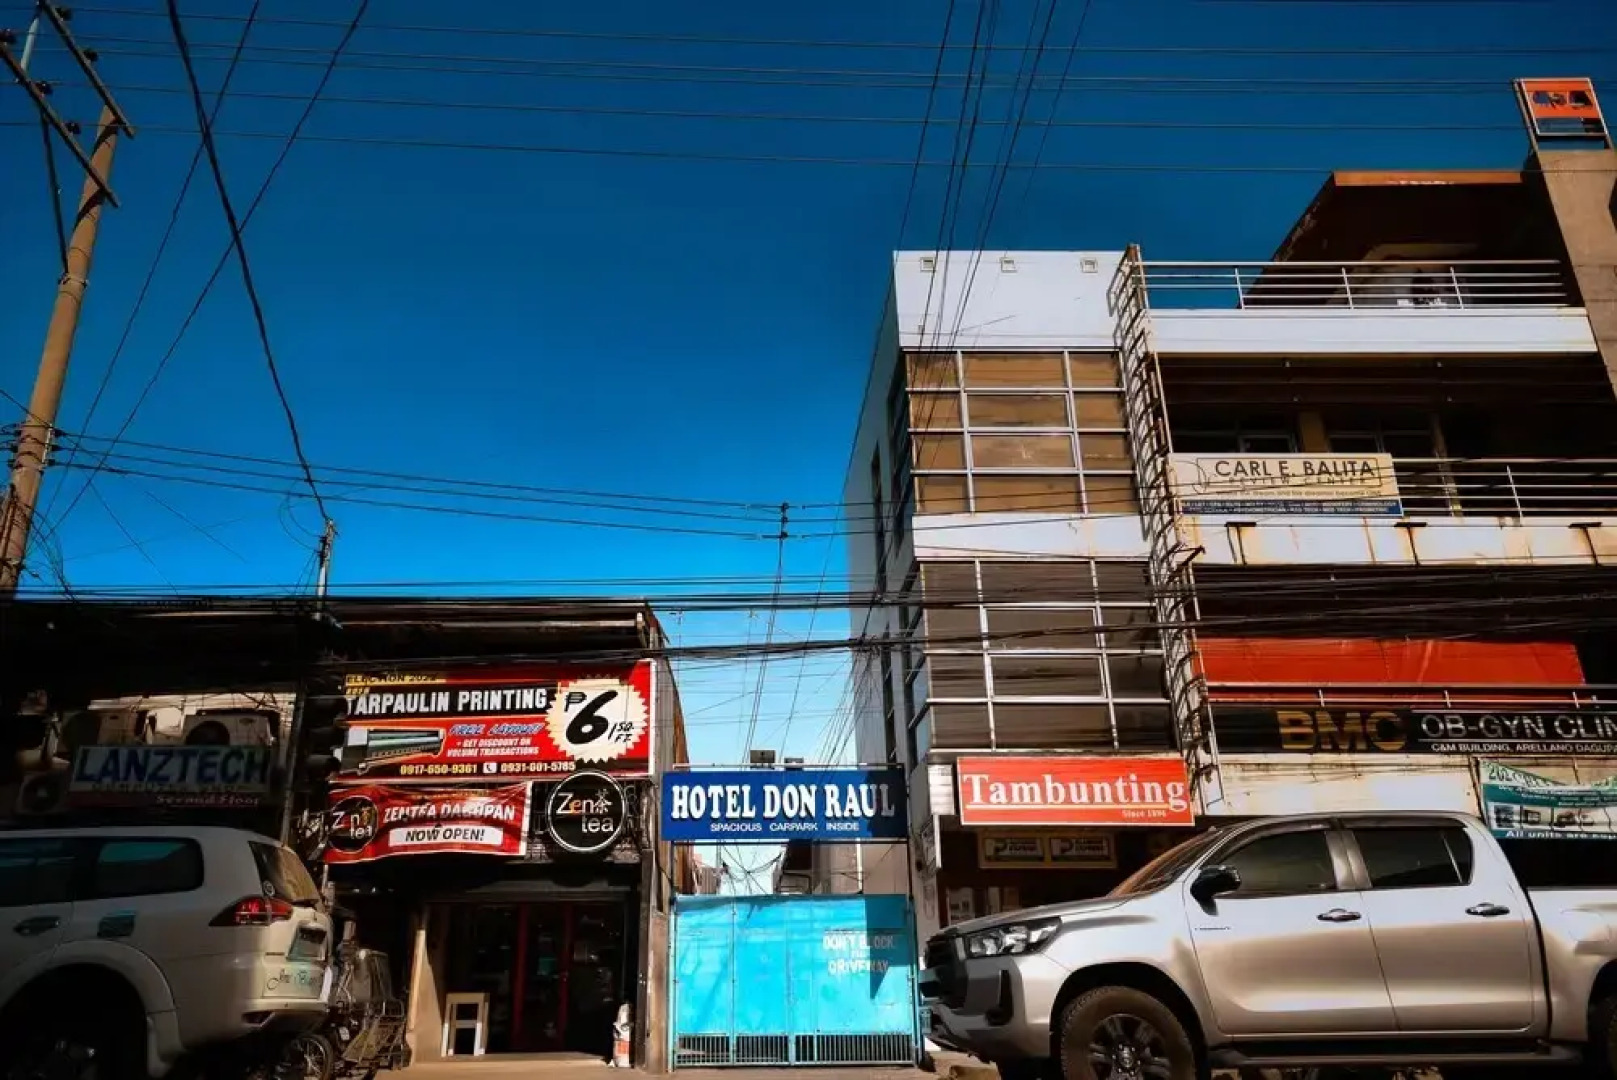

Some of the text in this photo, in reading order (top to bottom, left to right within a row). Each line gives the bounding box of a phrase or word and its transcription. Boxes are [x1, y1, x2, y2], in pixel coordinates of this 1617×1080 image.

[1215, 460, 1375, 478] CARL E. BALITA
[345, 688, 548, 715] TARPAULIN PRINTING
[1277, 710, 1407, 751] BMC
[1421, 714, 1547, 738] OB-GYN
[447, 746, 540, 758] VOLUME TRANSACTIONS
[478, 738, 520, 748] DISCOUNT
[1515, 743, 1573, 752] ARELLANO
[76, 748, 268, 783] LANZTECH
[671, 784, 895, 819] HOTEL DON RAUL
[963, 774, 1188, 812] Tambunting
[556, 792, 594, 814] Zen
[1121, 809, 1144, 818] Since
[582, 815, 614, 833] tea
[710, 822, 860, 832] SPACIOUS CARPARK INSIDE
[405, 828, 485, 842] NOW OPEN!
